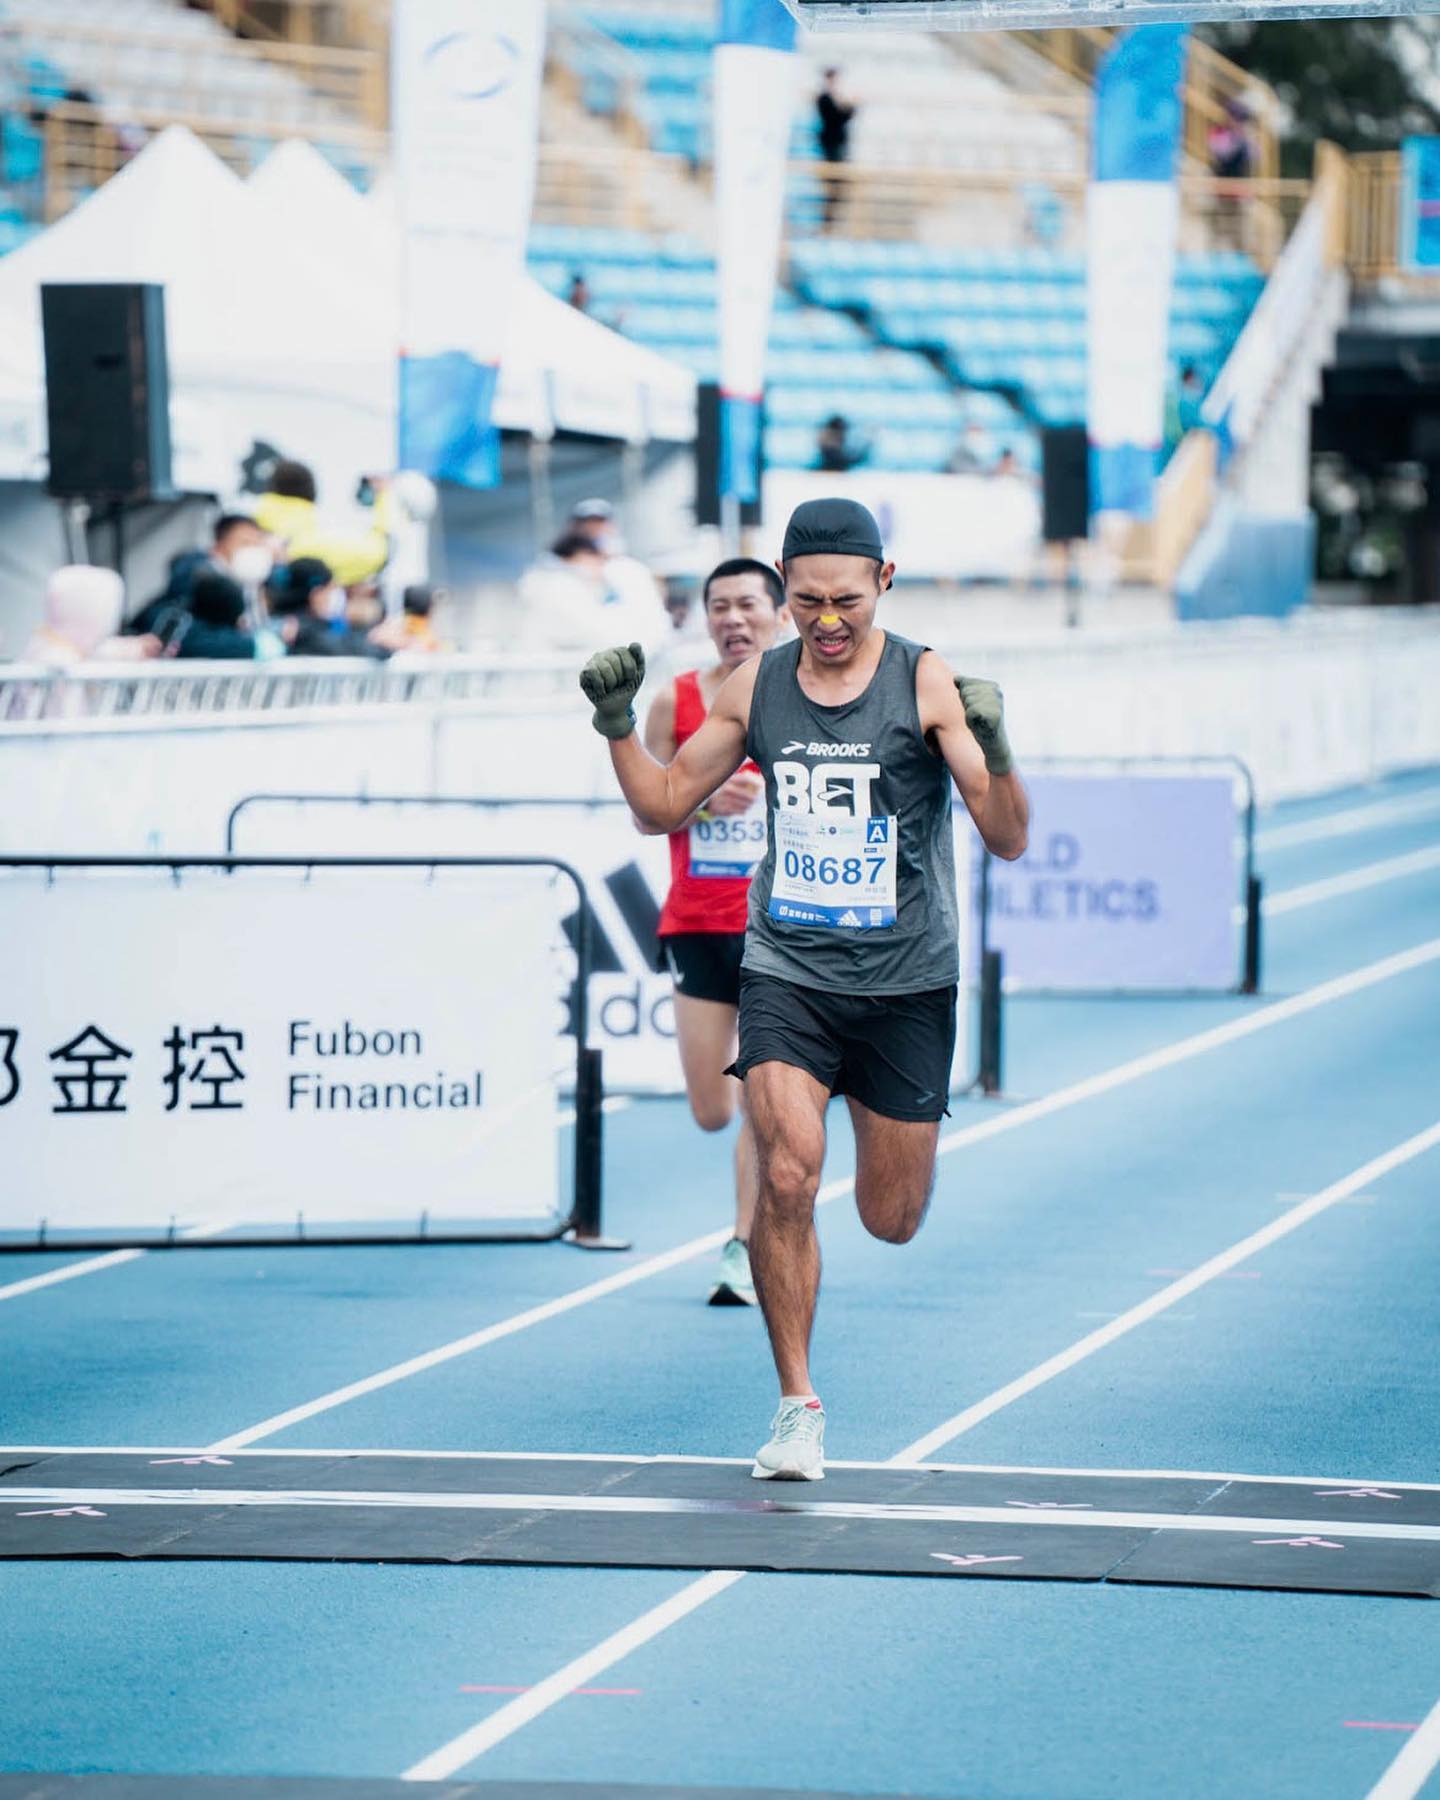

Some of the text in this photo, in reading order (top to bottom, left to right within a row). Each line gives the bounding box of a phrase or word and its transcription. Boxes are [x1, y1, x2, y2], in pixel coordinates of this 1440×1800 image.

[806, 742, 872, 757] BROOKS
[773, 761, 881, 817] BET
[695, 820, 766, 843] 0353
[869, 825, 886, 842] A
[784, 850, 887, 885] 08687
[288, 1021, 422, 1057] Fubon
[288, 1072, 483, 1110] Financial
